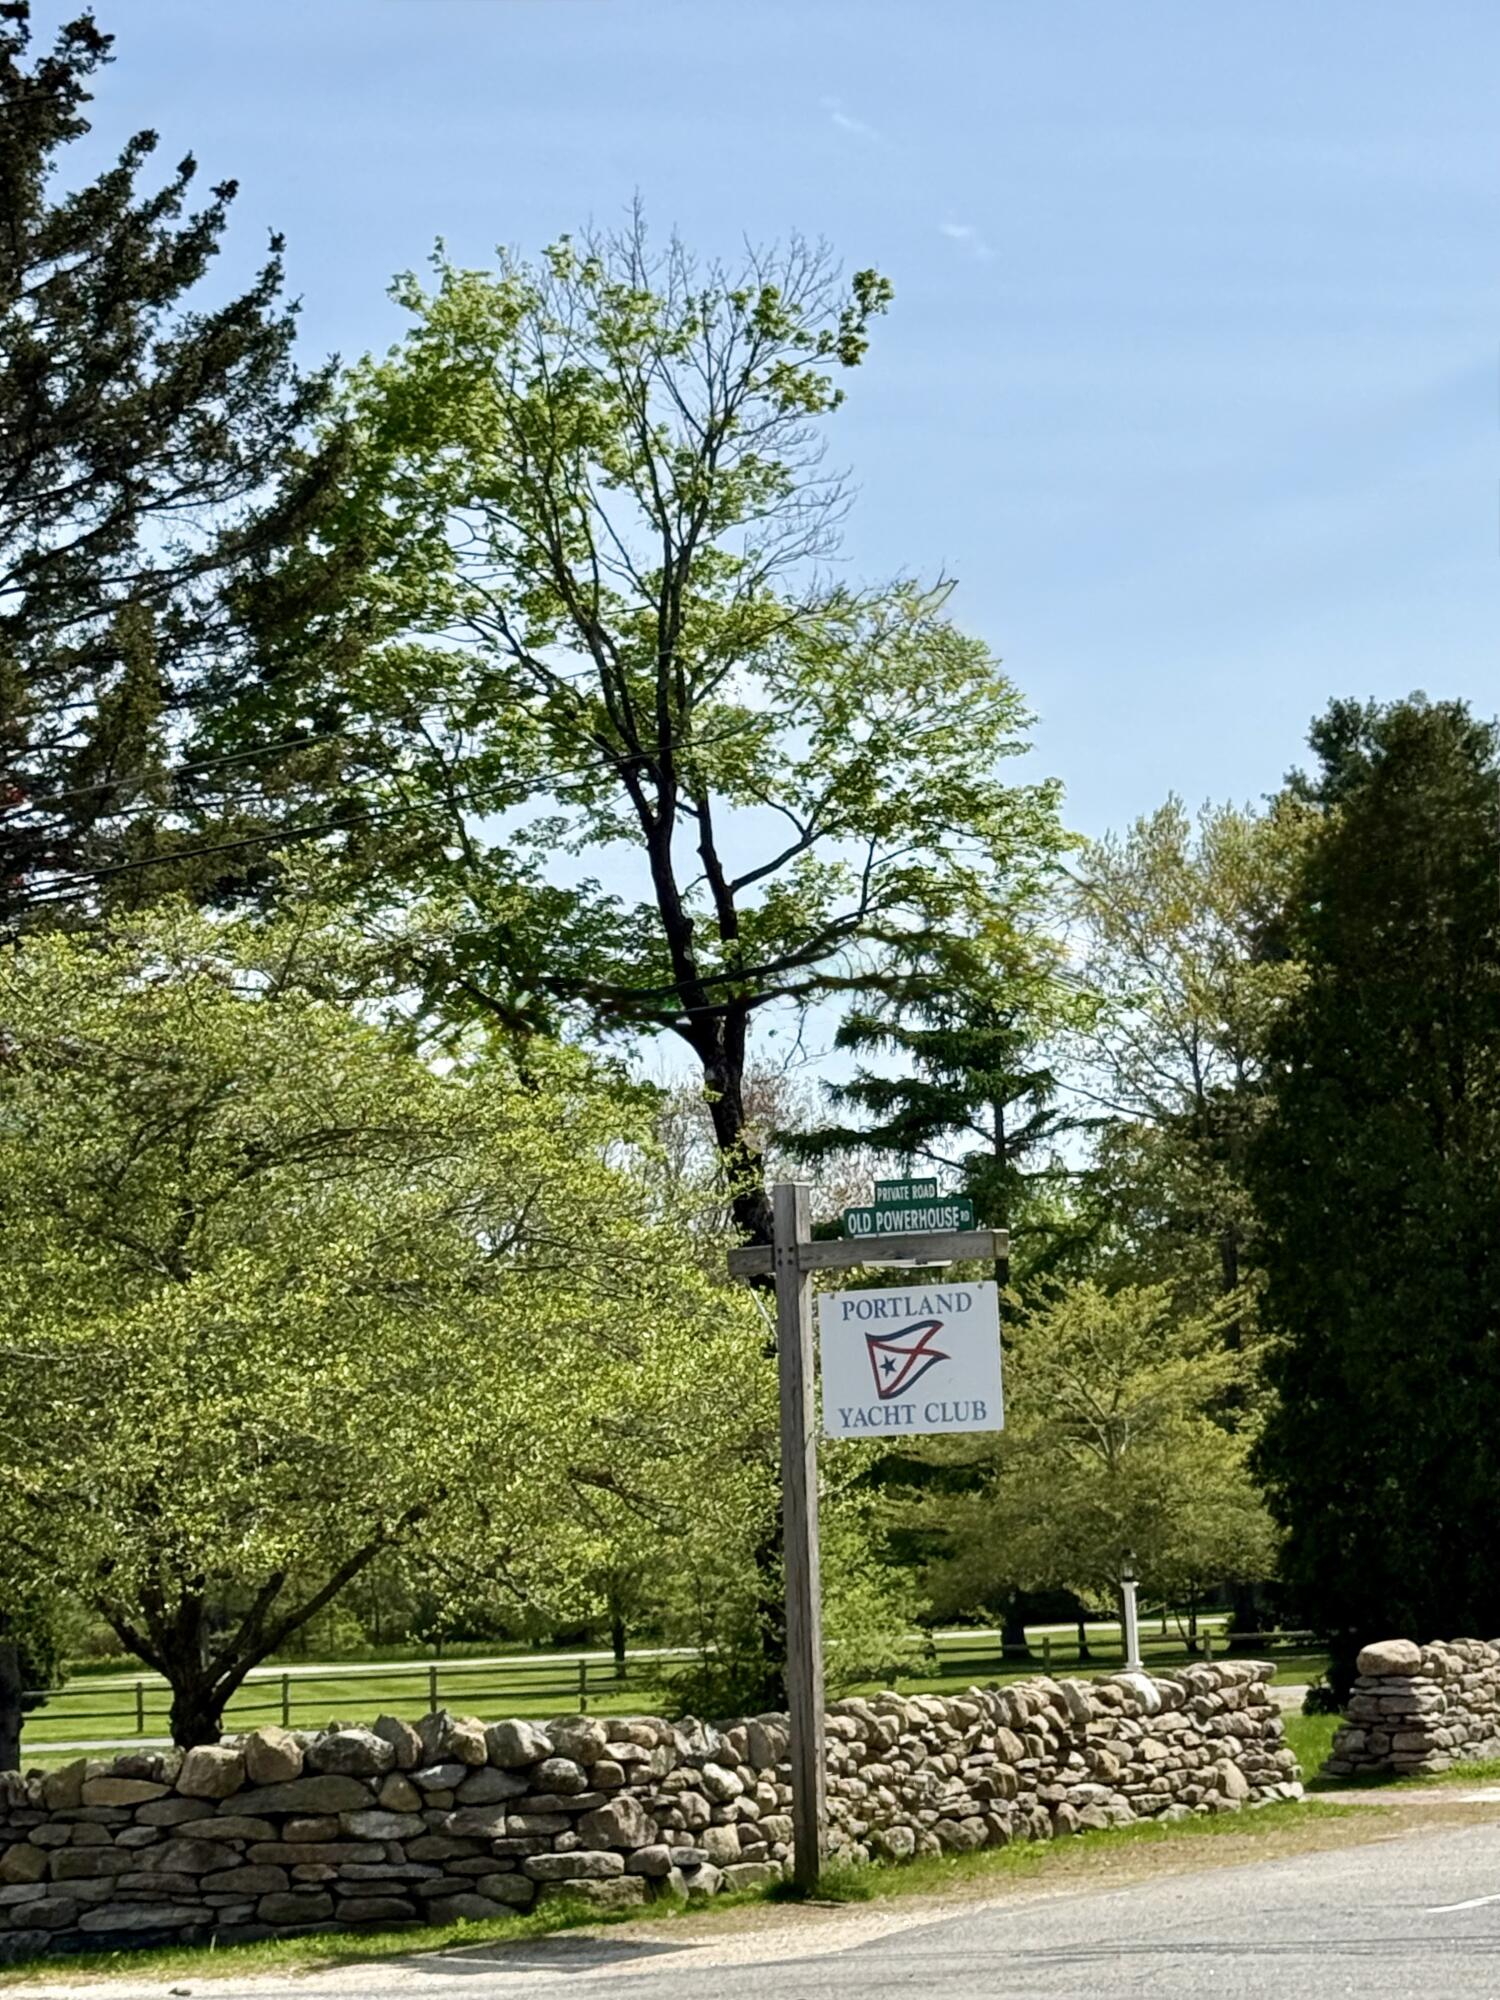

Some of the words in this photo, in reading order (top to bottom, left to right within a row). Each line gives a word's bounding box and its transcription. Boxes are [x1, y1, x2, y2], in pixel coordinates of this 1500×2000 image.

[877, 1186, 909, 1202] PRIVATE
[912, 1184, 935, 1199] ROAD
[848, 1213, 871, 1234] OLD
[876, 1206, 960, 1231] POWERHOUSE
[841, 1292, 972, 1321] PORTLAND
[839, 1404, 916, 1428] YACHT
[924, 1400, 988, 1424] CLUB
